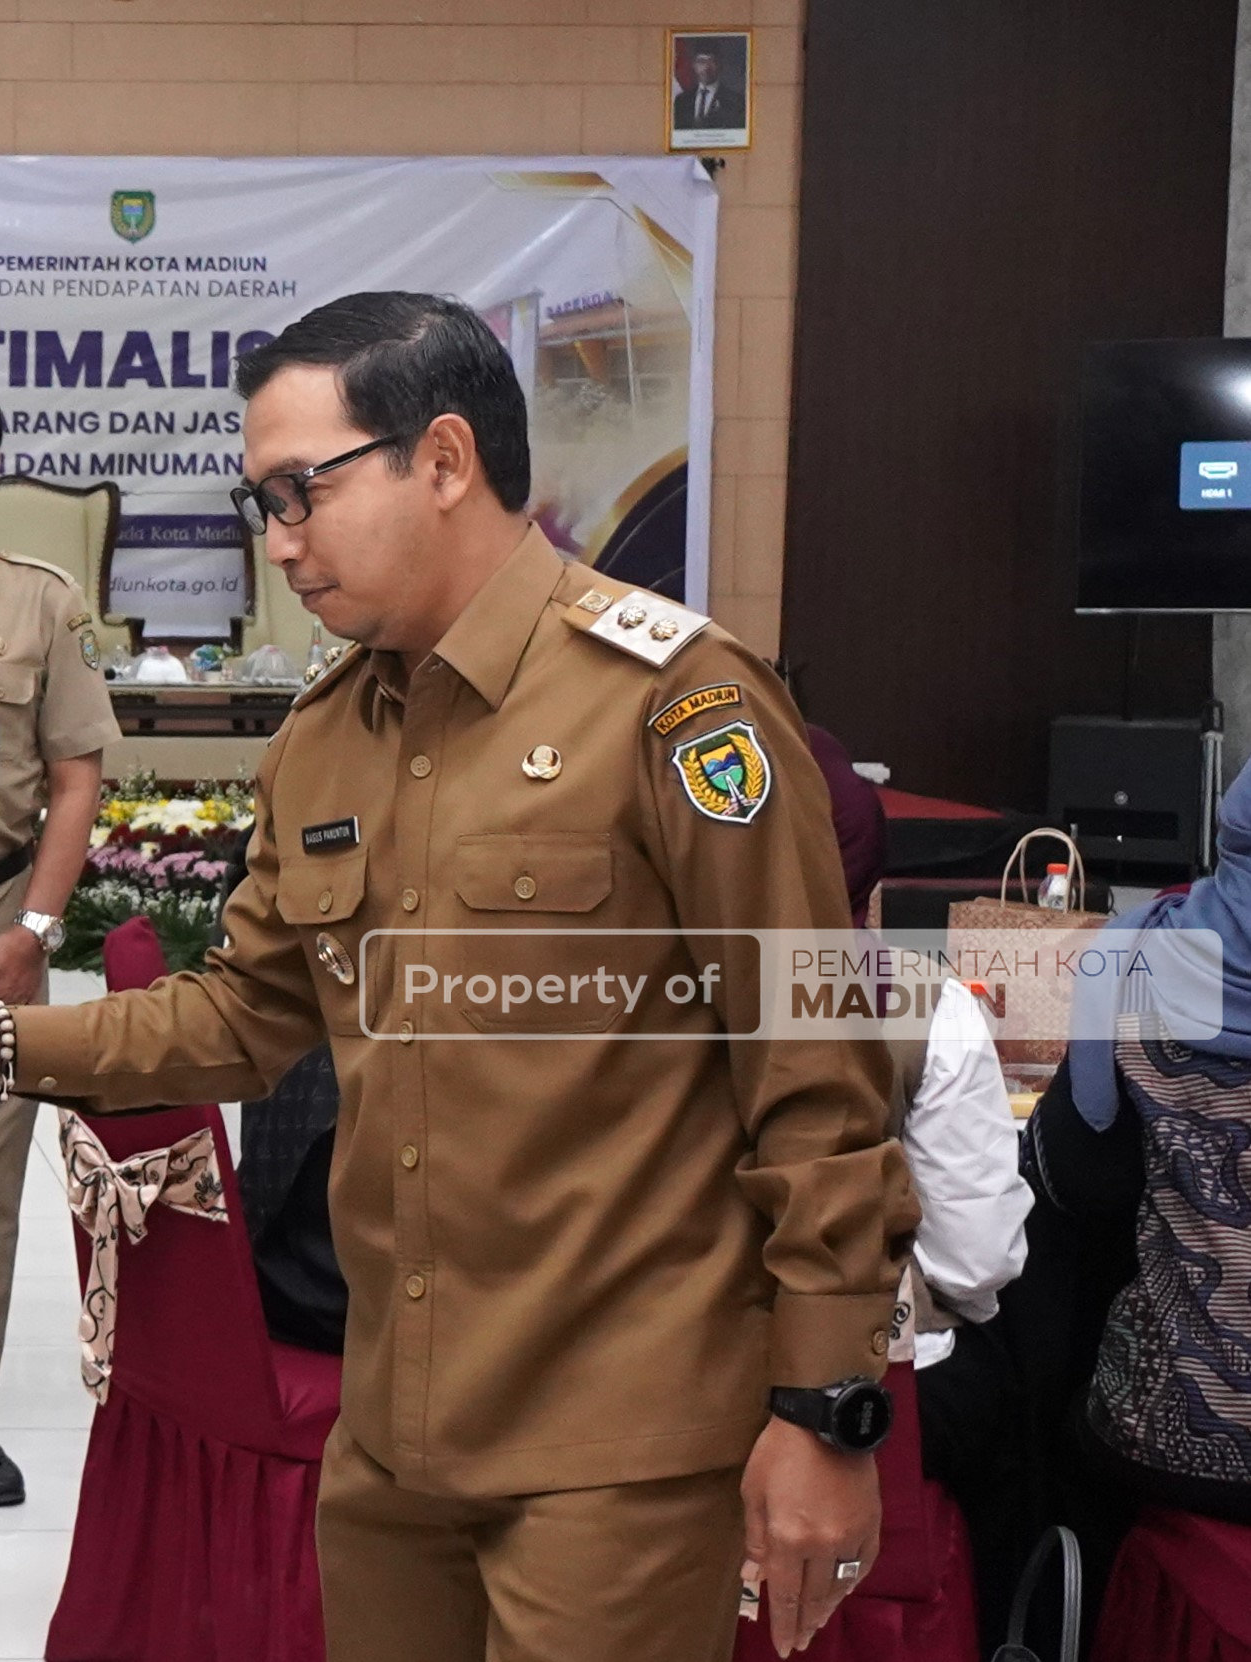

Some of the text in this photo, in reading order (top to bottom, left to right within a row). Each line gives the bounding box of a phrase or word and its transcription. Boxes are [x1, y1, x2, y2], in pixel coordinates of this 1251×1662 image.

[125, 256, 180, 272] KOTA
[185, 256, 268, 273] MADIUN
[52, 279, 200, 298] PENDAPATAN
[207, 279, 297, 298] DAERAH
[108, 410, 175, 434] DAN
[15, 452, 81, 476] DAN
[88, 452, 244, 476] MINUMAN
[151, 526, 189, 541] Kota
[657, 689, 736, 732] KOTA MADIUN
